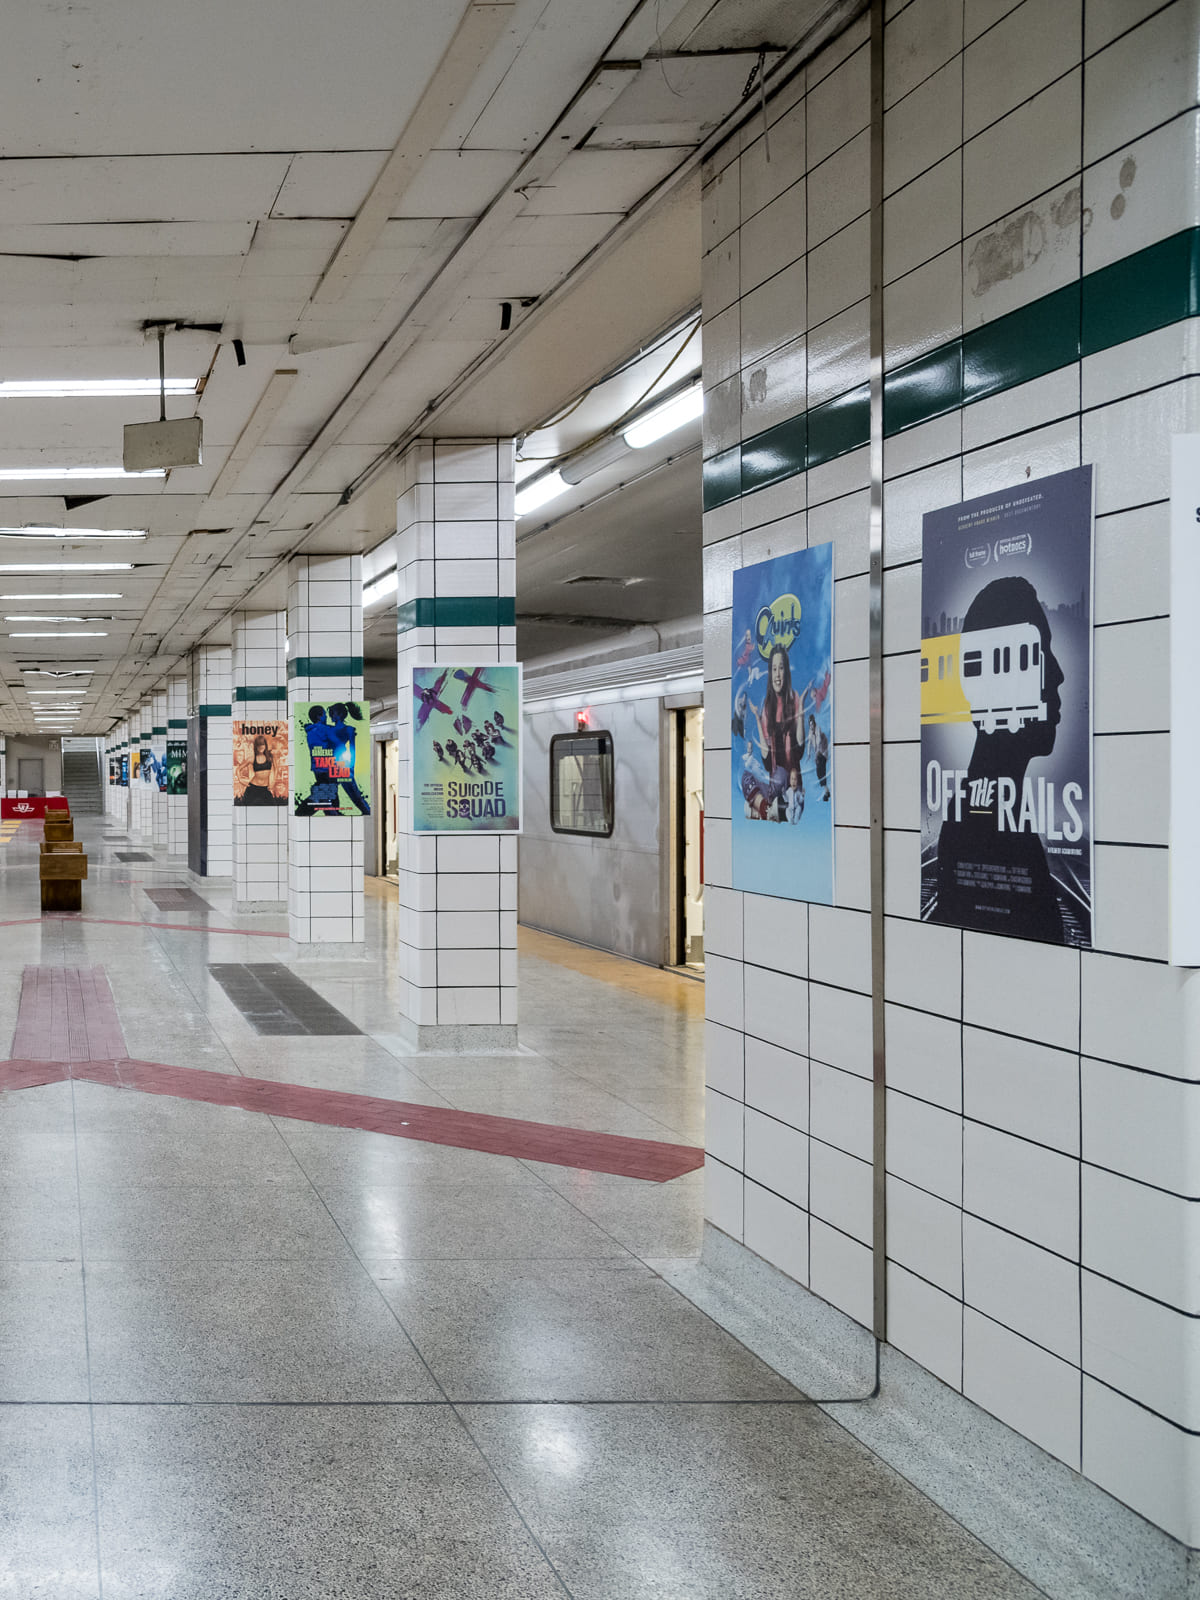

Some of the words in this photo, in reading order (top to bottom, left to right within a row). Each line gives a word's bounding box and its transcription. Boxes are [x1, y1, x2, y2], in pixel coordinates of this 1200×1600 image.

[241, 723, 278, 738] honey
[313, 756, 336, 768] TAKE
[328, 767, 351, 778] LEAD
[447, 780, 504, 798] SUICIDE
[926, 759, 968, 823] OFF
[968, 776, 998, 808] THE
[997, 776, 1084, 843] RAILS
[446, 798, 506, 821] SQUAD
